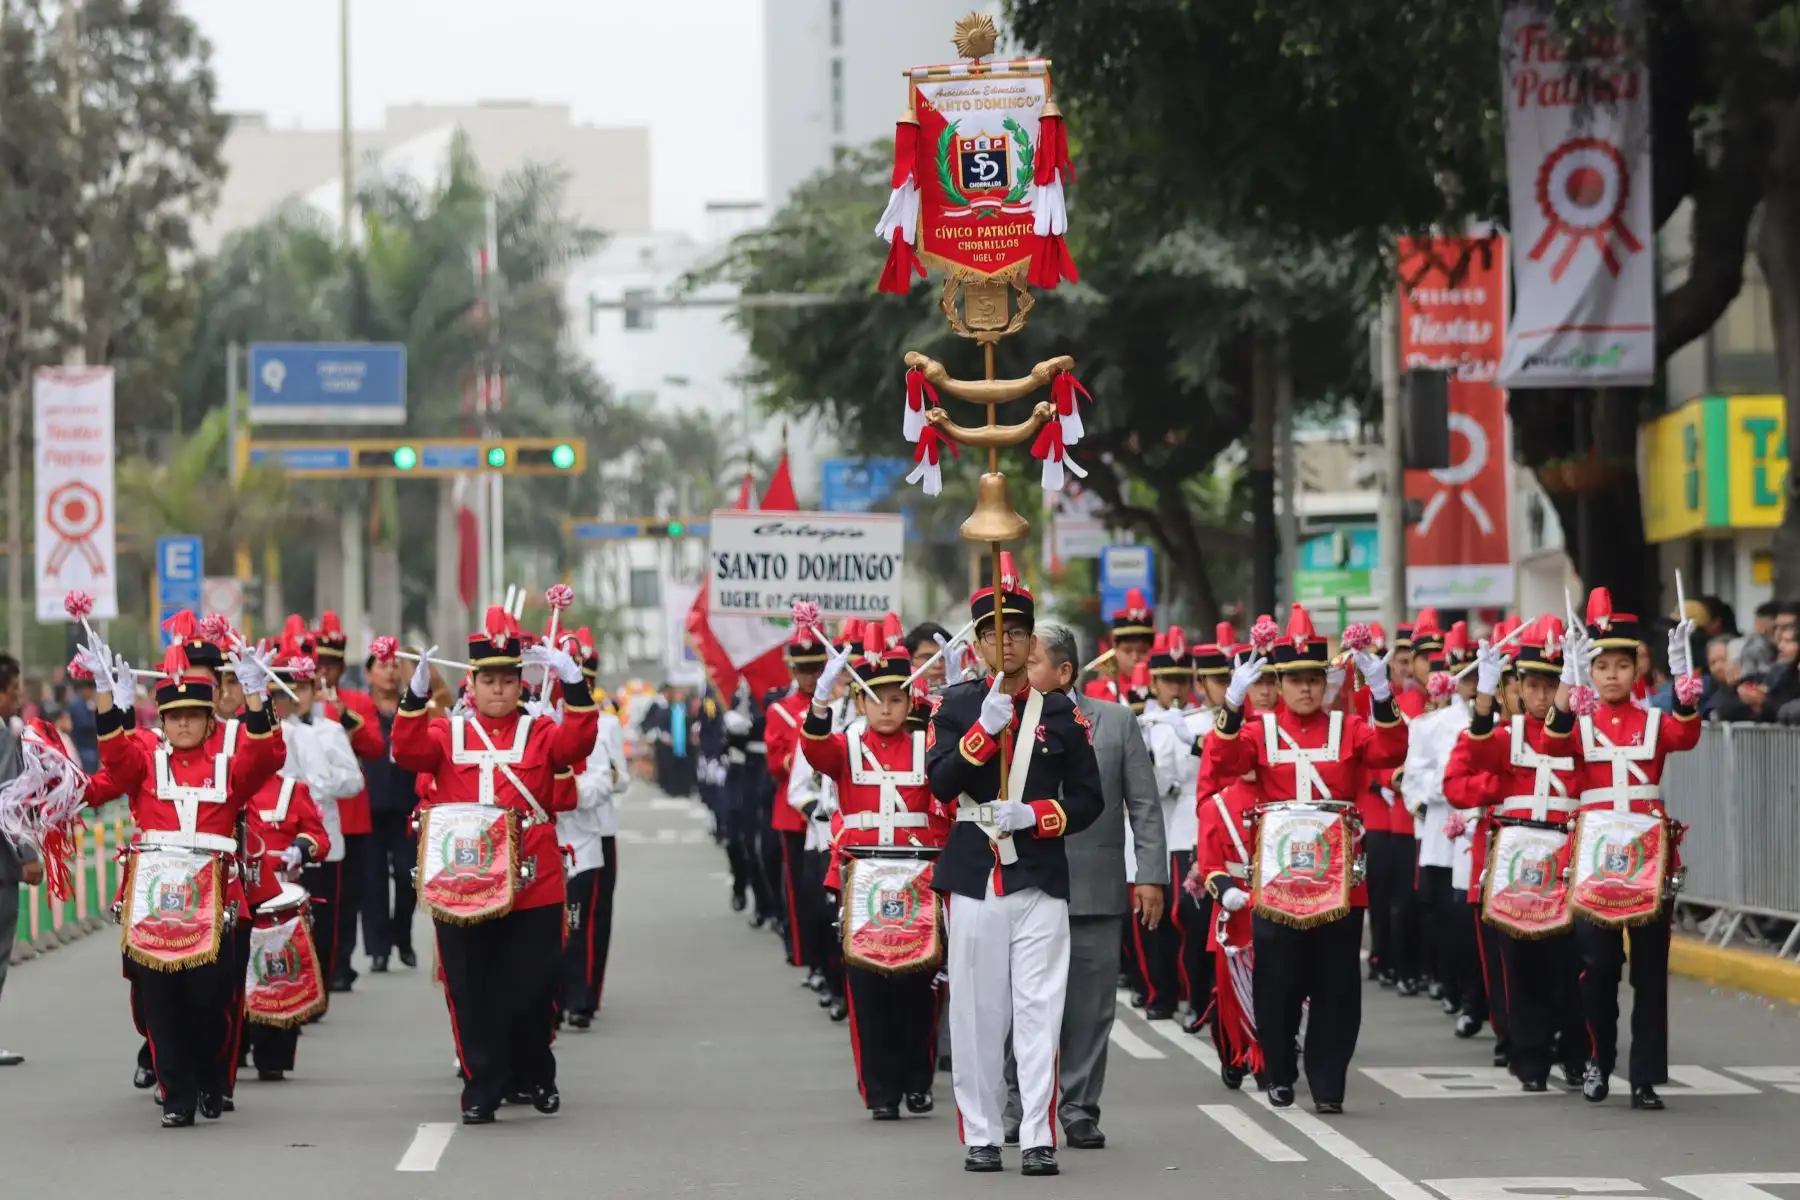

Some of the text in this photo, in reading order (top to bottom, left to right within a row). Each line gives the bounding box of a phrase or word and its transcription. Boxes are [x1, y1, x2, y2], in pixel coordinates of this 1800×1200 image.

[935, 221, 1033, 239] CÍVICO PATRIÓTIC
[958, 239, 1020, 250] CHORRILLOS
[973, 252, 1006, 262] UGEL 07
[165, 542, 194, 579] E
[719, 590, 760, 609] UGEL
